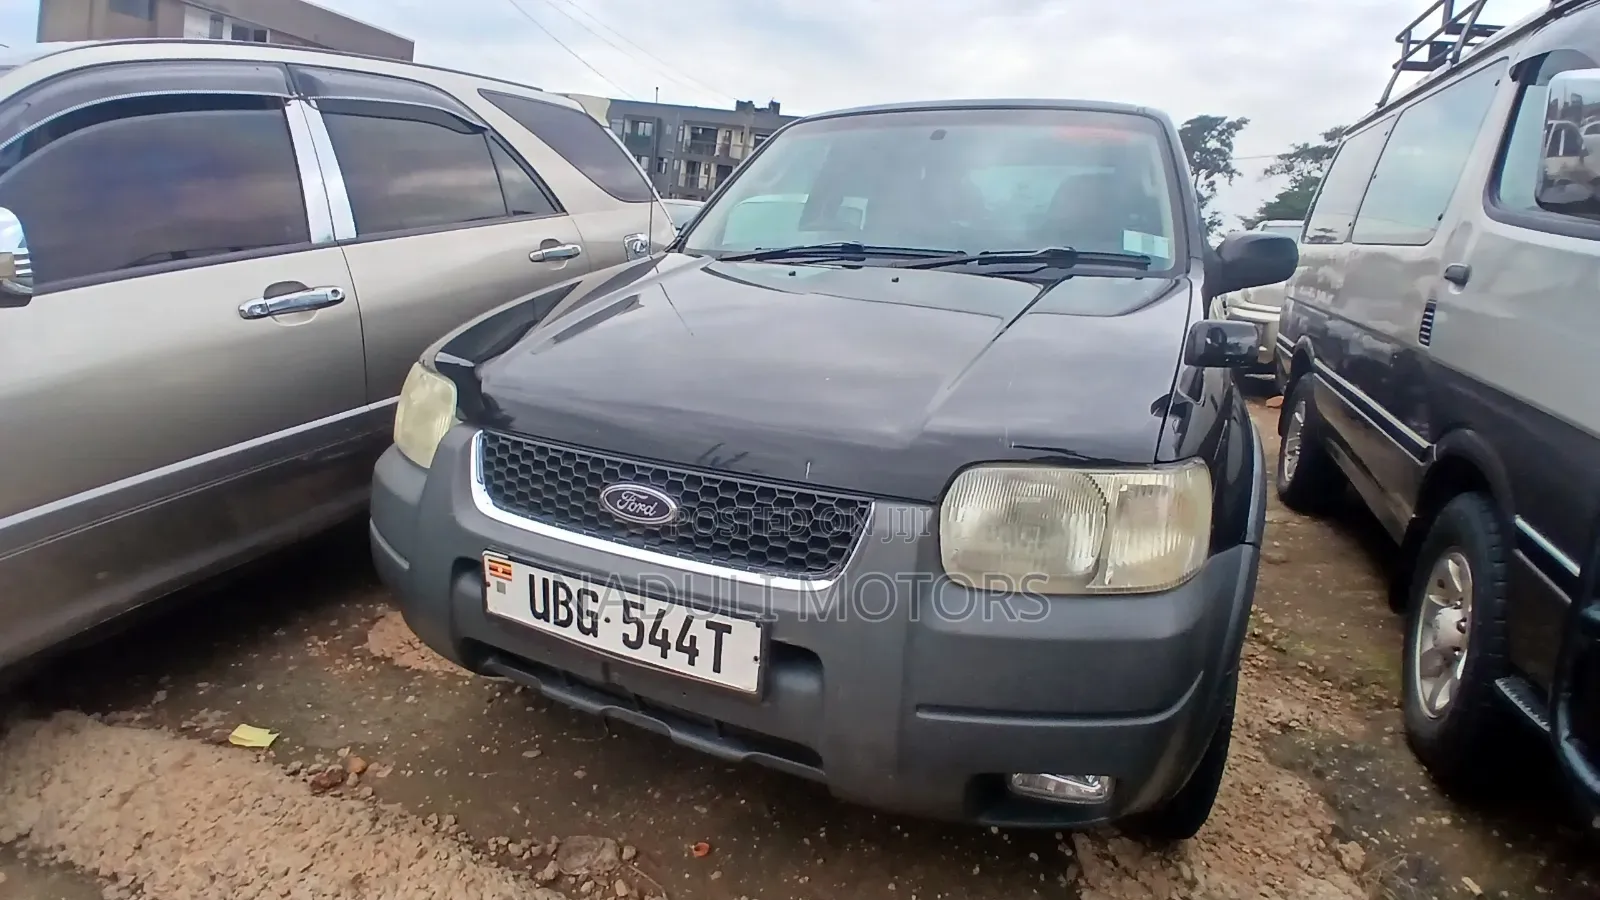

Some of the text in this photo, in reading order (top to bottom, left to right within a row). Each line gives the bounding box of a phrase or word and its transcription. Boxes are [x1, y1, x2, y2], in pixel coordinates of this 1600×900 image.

[616, 490, 658, 517] Ford
[528, 573, 733, 674] UBG 544T
